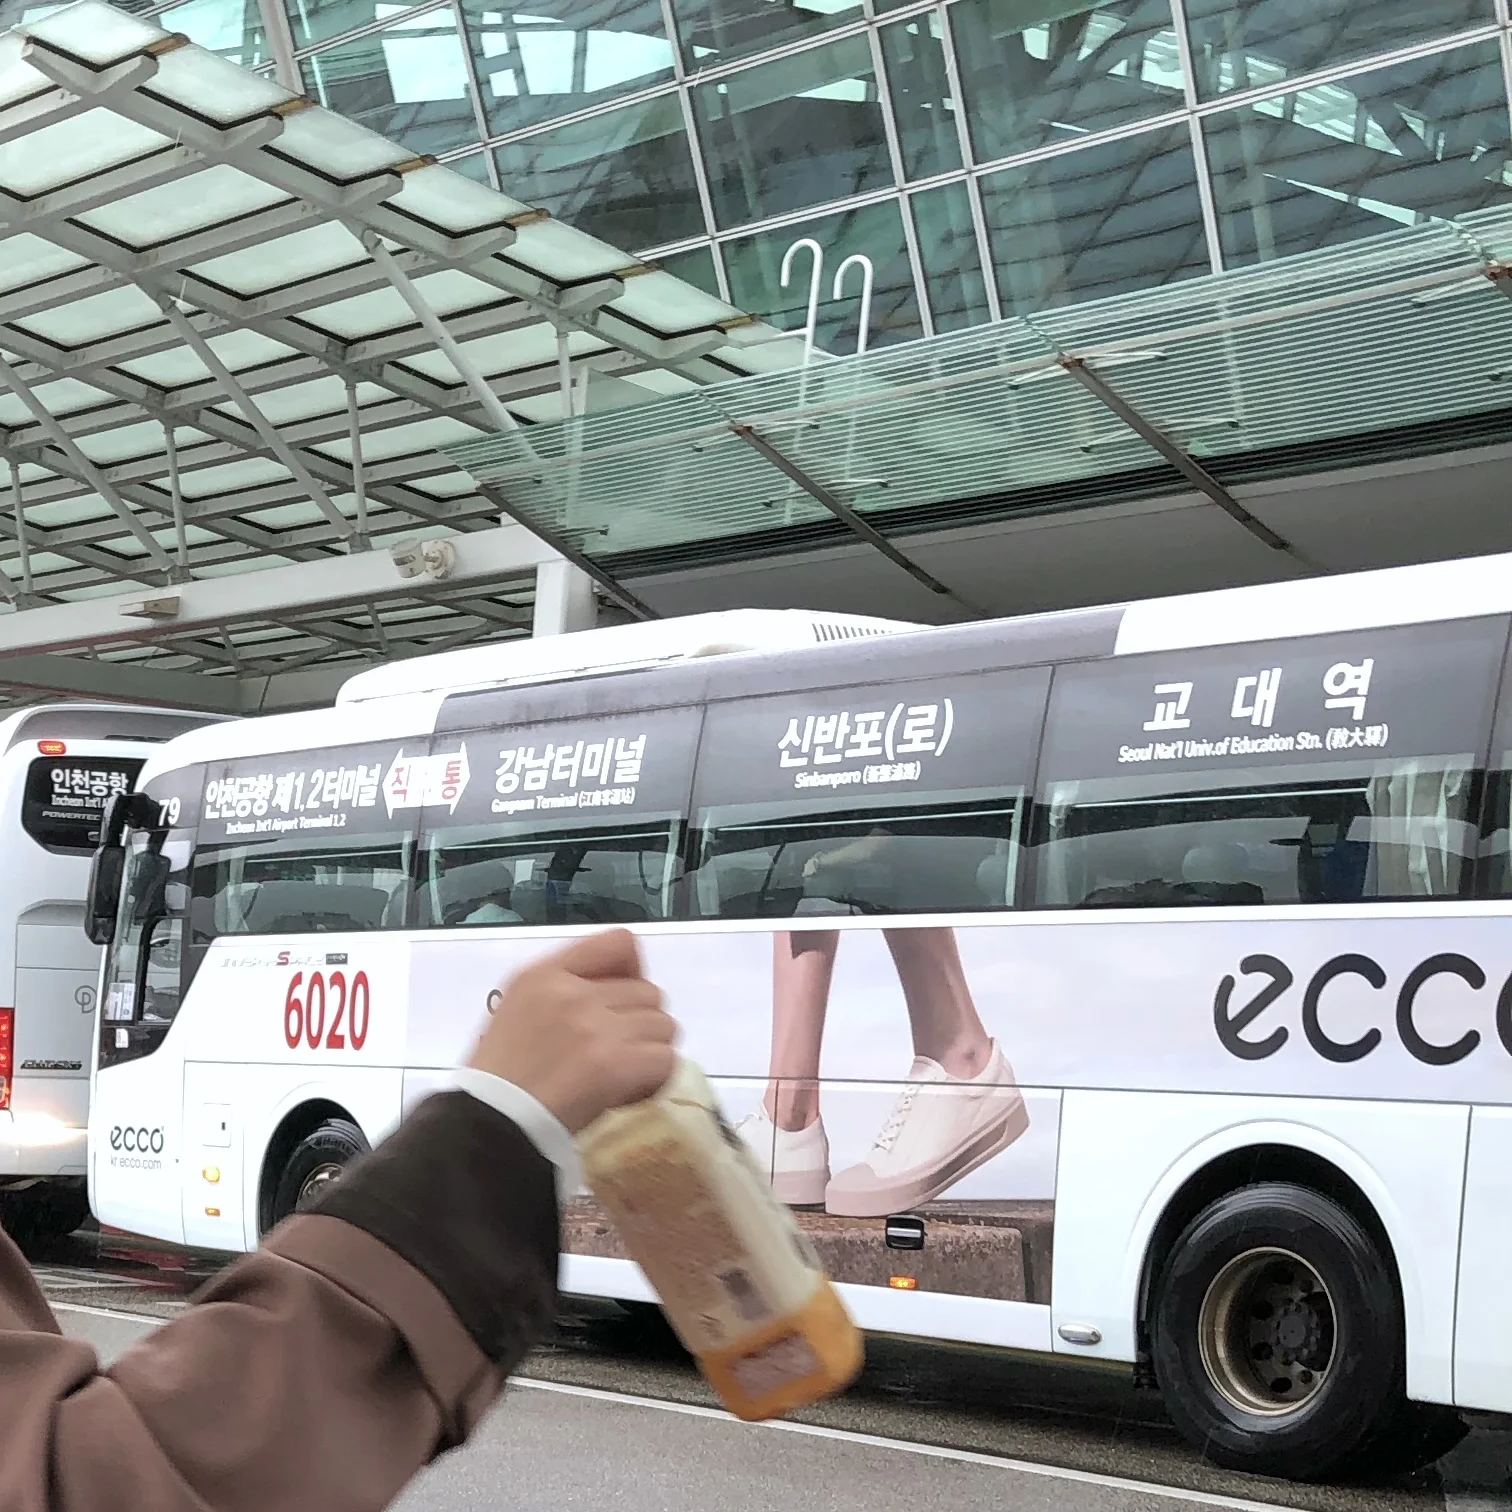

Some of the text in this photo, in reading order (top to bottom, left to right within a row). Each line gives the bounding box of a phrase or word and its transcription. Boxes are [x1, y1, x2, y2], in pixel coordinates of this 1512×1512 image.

[777, 697, 954, 768] 신반포(로)
[1117, 744, 1152, 763] Seoul
[1230, 733, 1294, 755] Education
[50, 768, 129, 796] 인천공항
[494, 733, 647, 794] 강남터미널
[204, 773, 274, 819] 인천공항
[298, 814, 332, 830] Terminal
[284, 970, 370, 1051] 6020
[1213, 952, 1512, 1066] ecc
[110, 1125, 164, 1154] ecco
